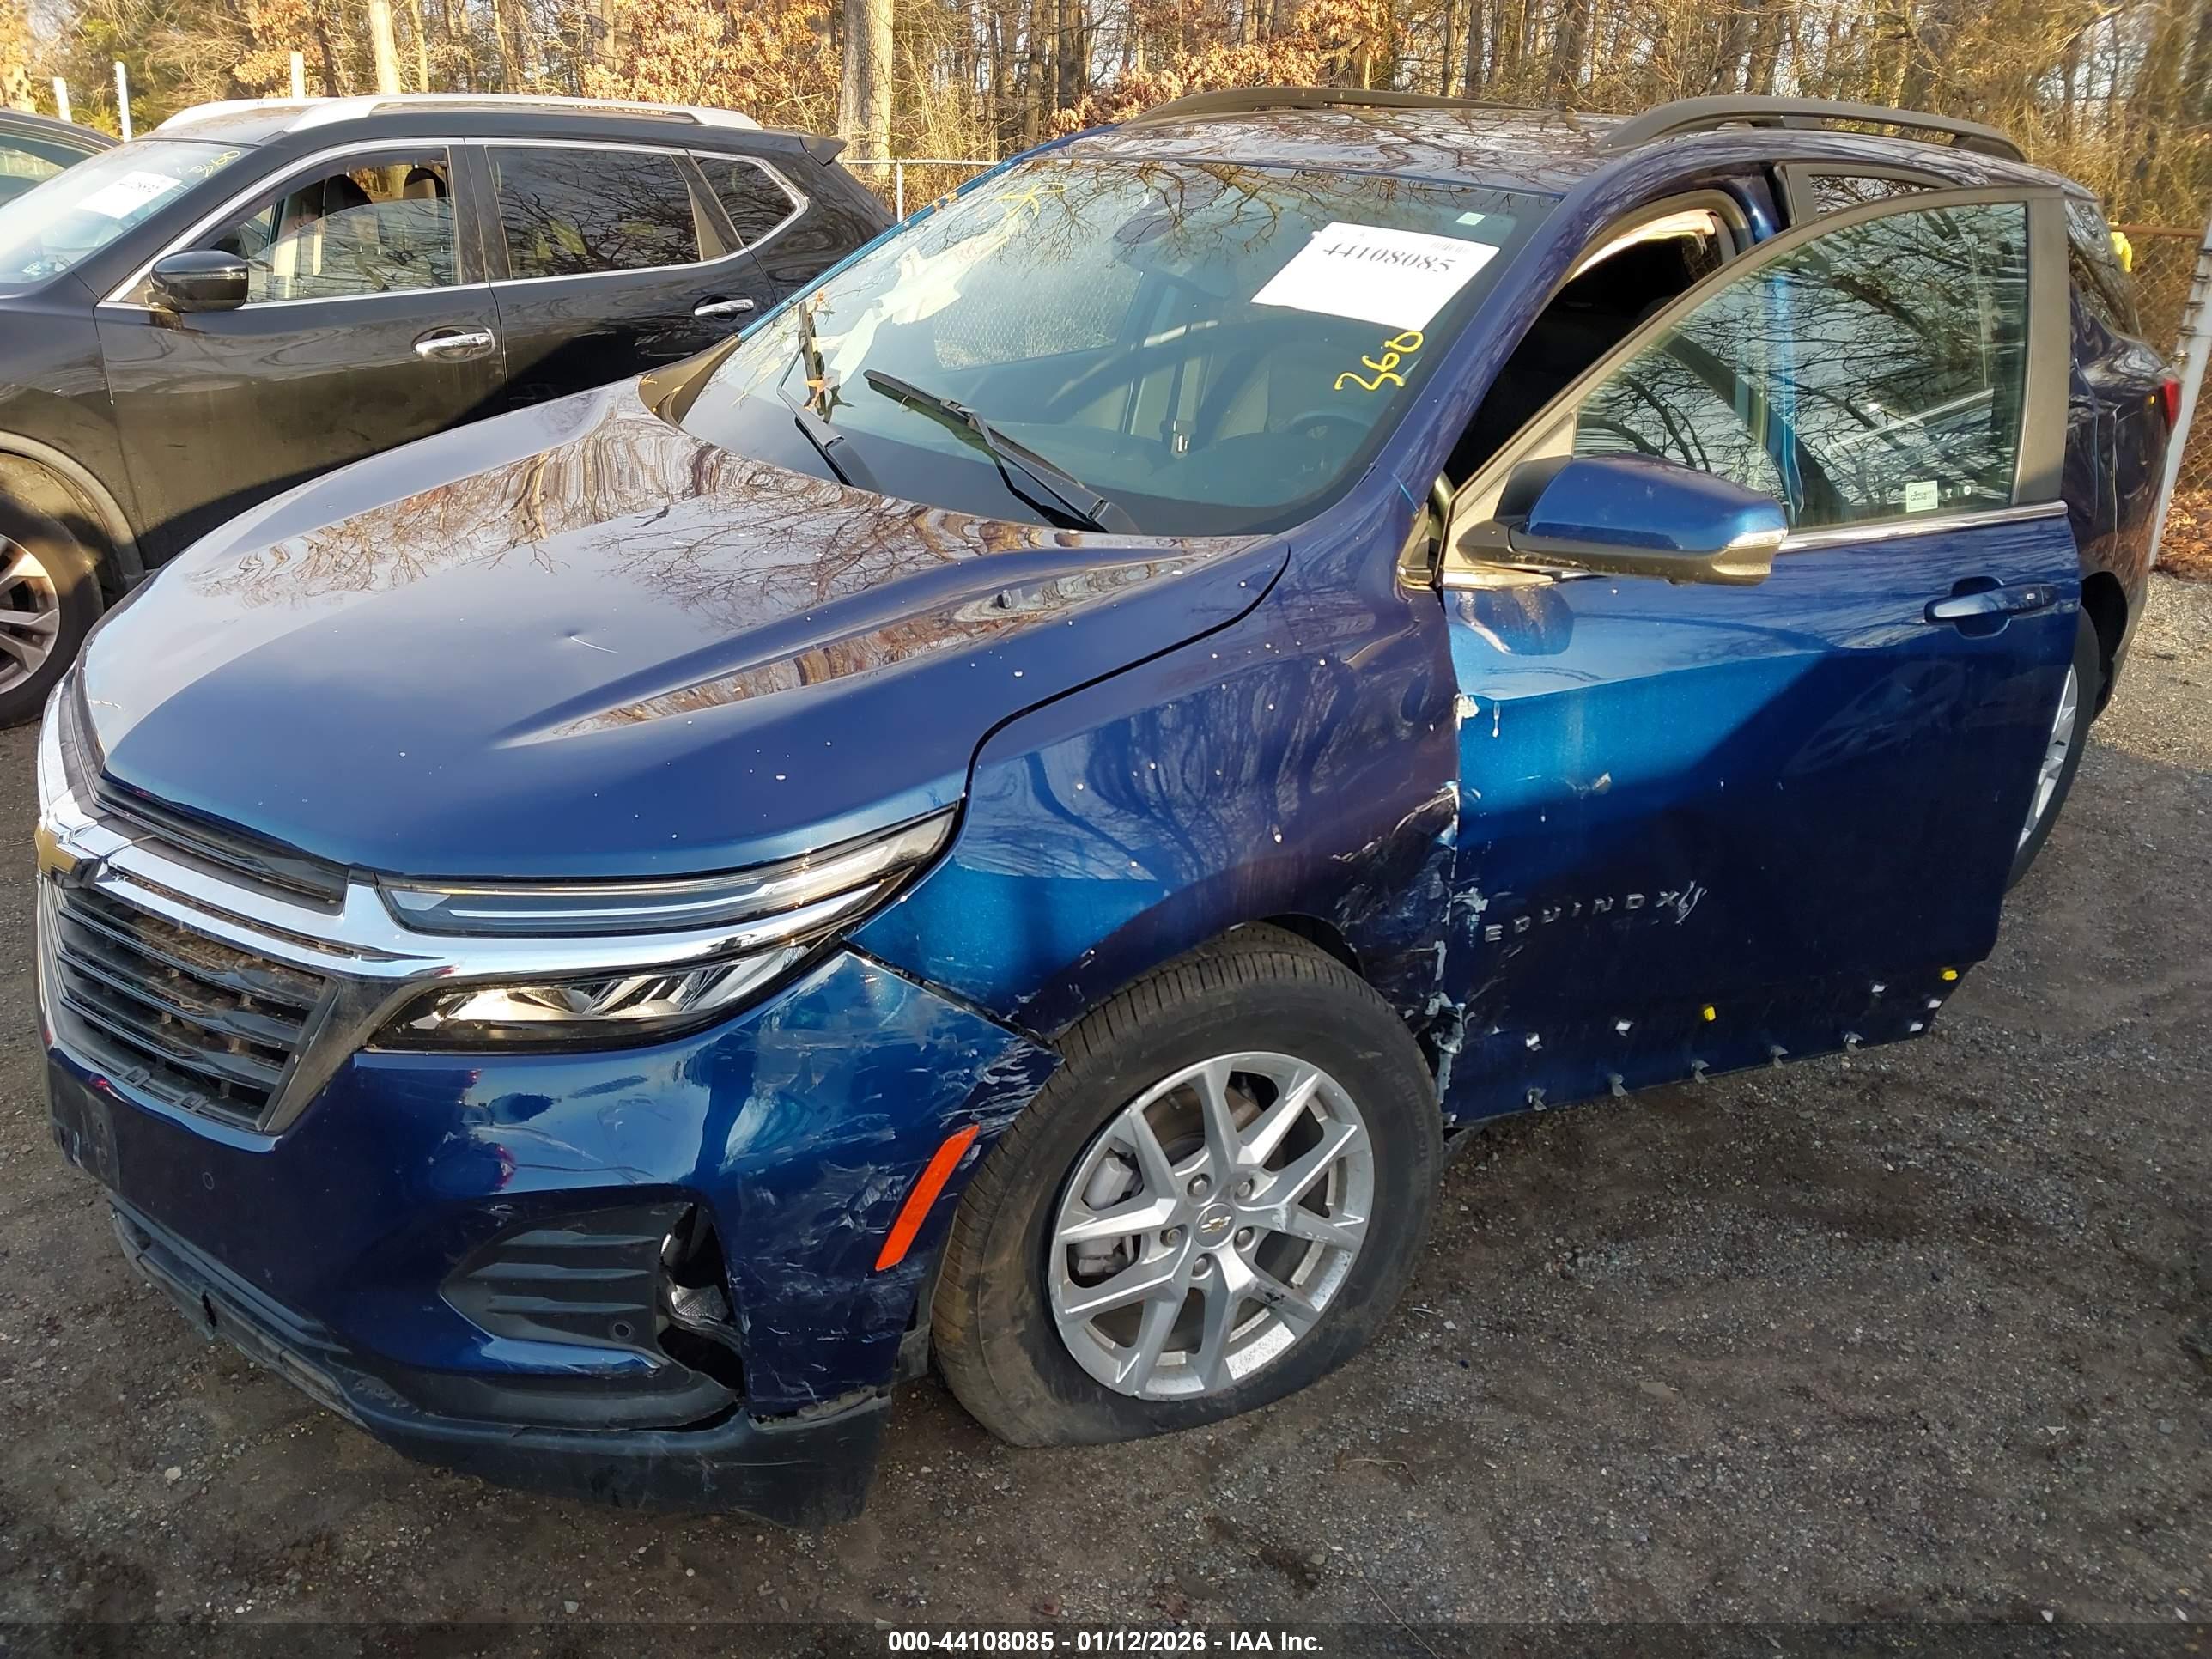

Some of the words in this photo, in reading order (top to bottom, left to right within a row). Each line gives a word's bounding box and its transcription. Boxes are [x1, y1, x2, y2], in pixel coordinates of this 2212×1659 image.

[1323, 242, 1456, 273] 44108085
[1334, 331, 1424, 390] 360
[1485, 890, 1680, 942] EQUINOX
